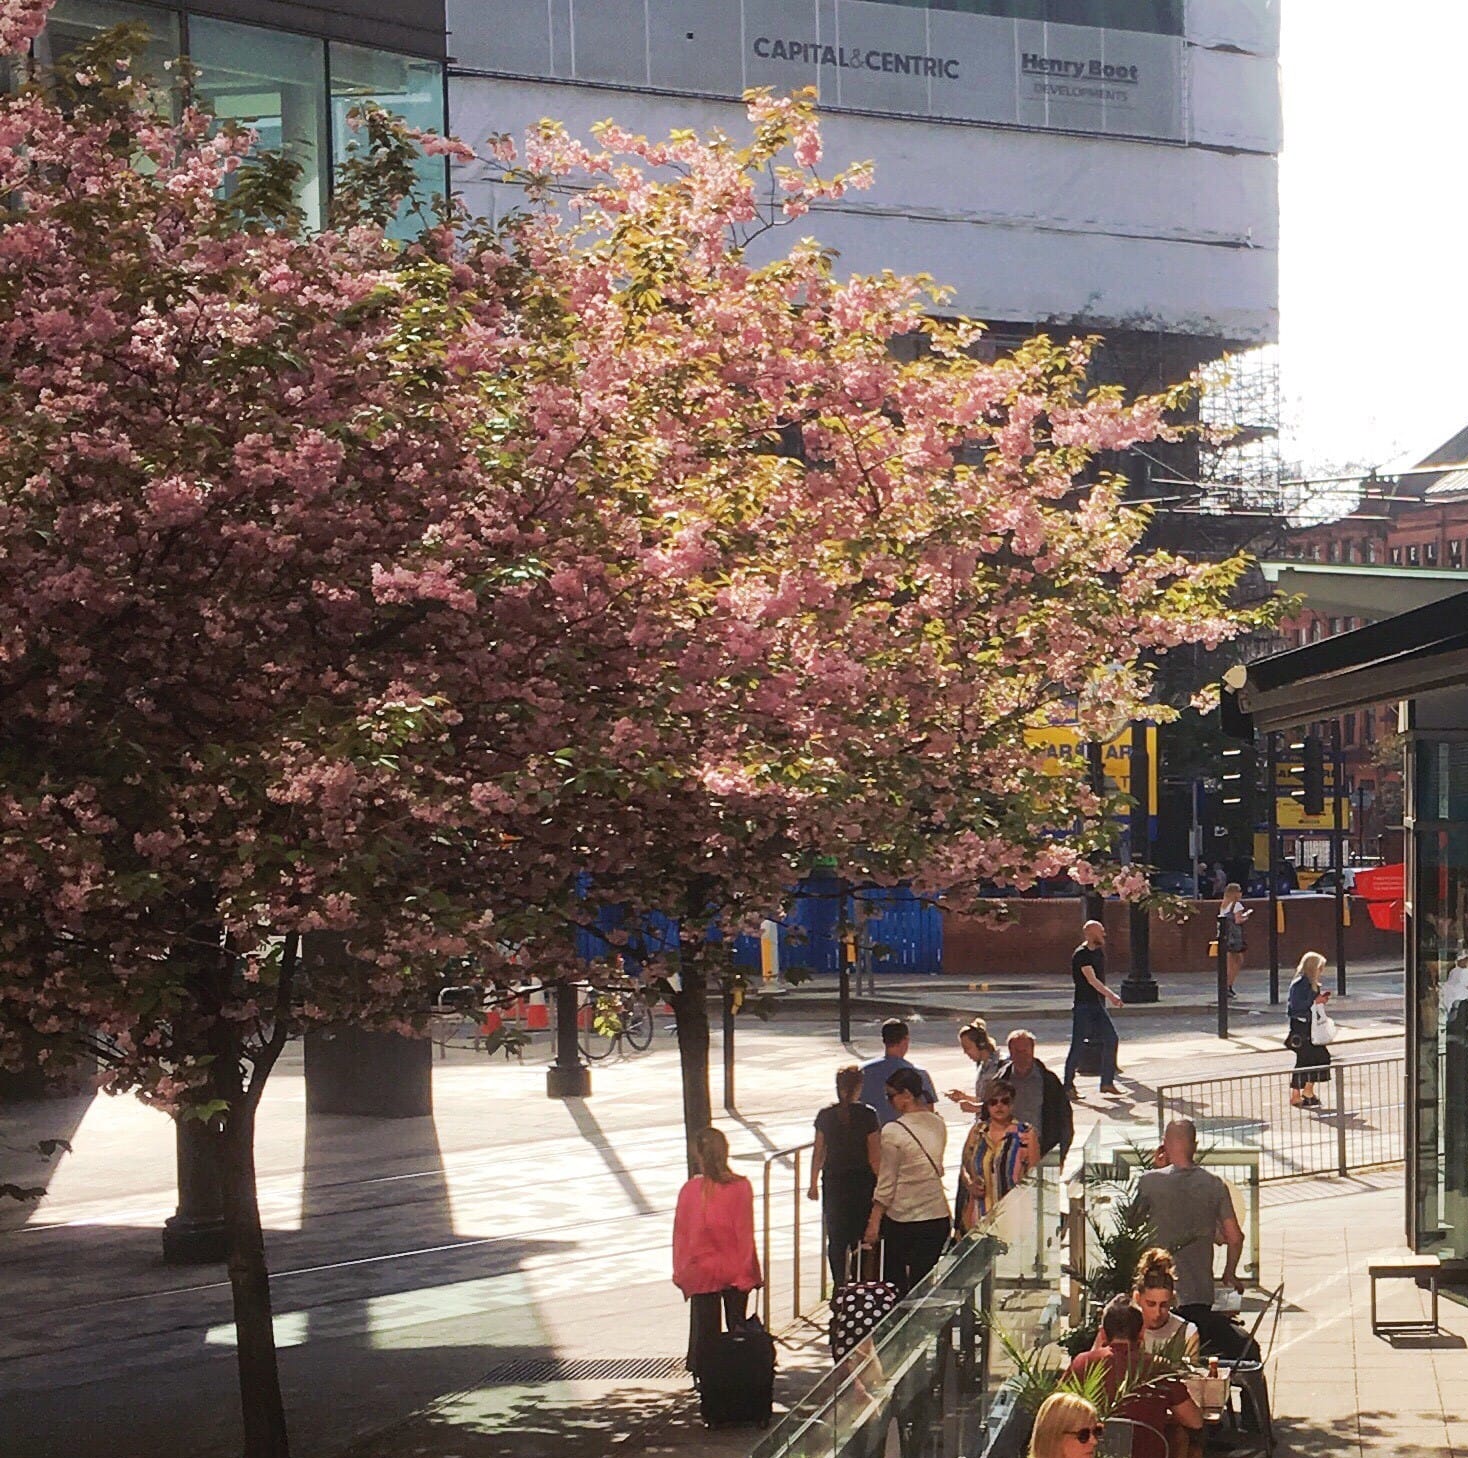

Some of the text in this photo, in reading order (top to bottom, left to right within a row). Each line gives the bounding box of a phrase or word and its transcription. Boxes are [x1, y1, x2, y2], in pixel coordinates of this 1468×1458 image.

[753, 37, 960, 79] CAPITAL&CENTRIC
[1022, 53, 1138, 79] Henry Boot
[1033, 83, 1129, 101] DEVELOPMENTS
